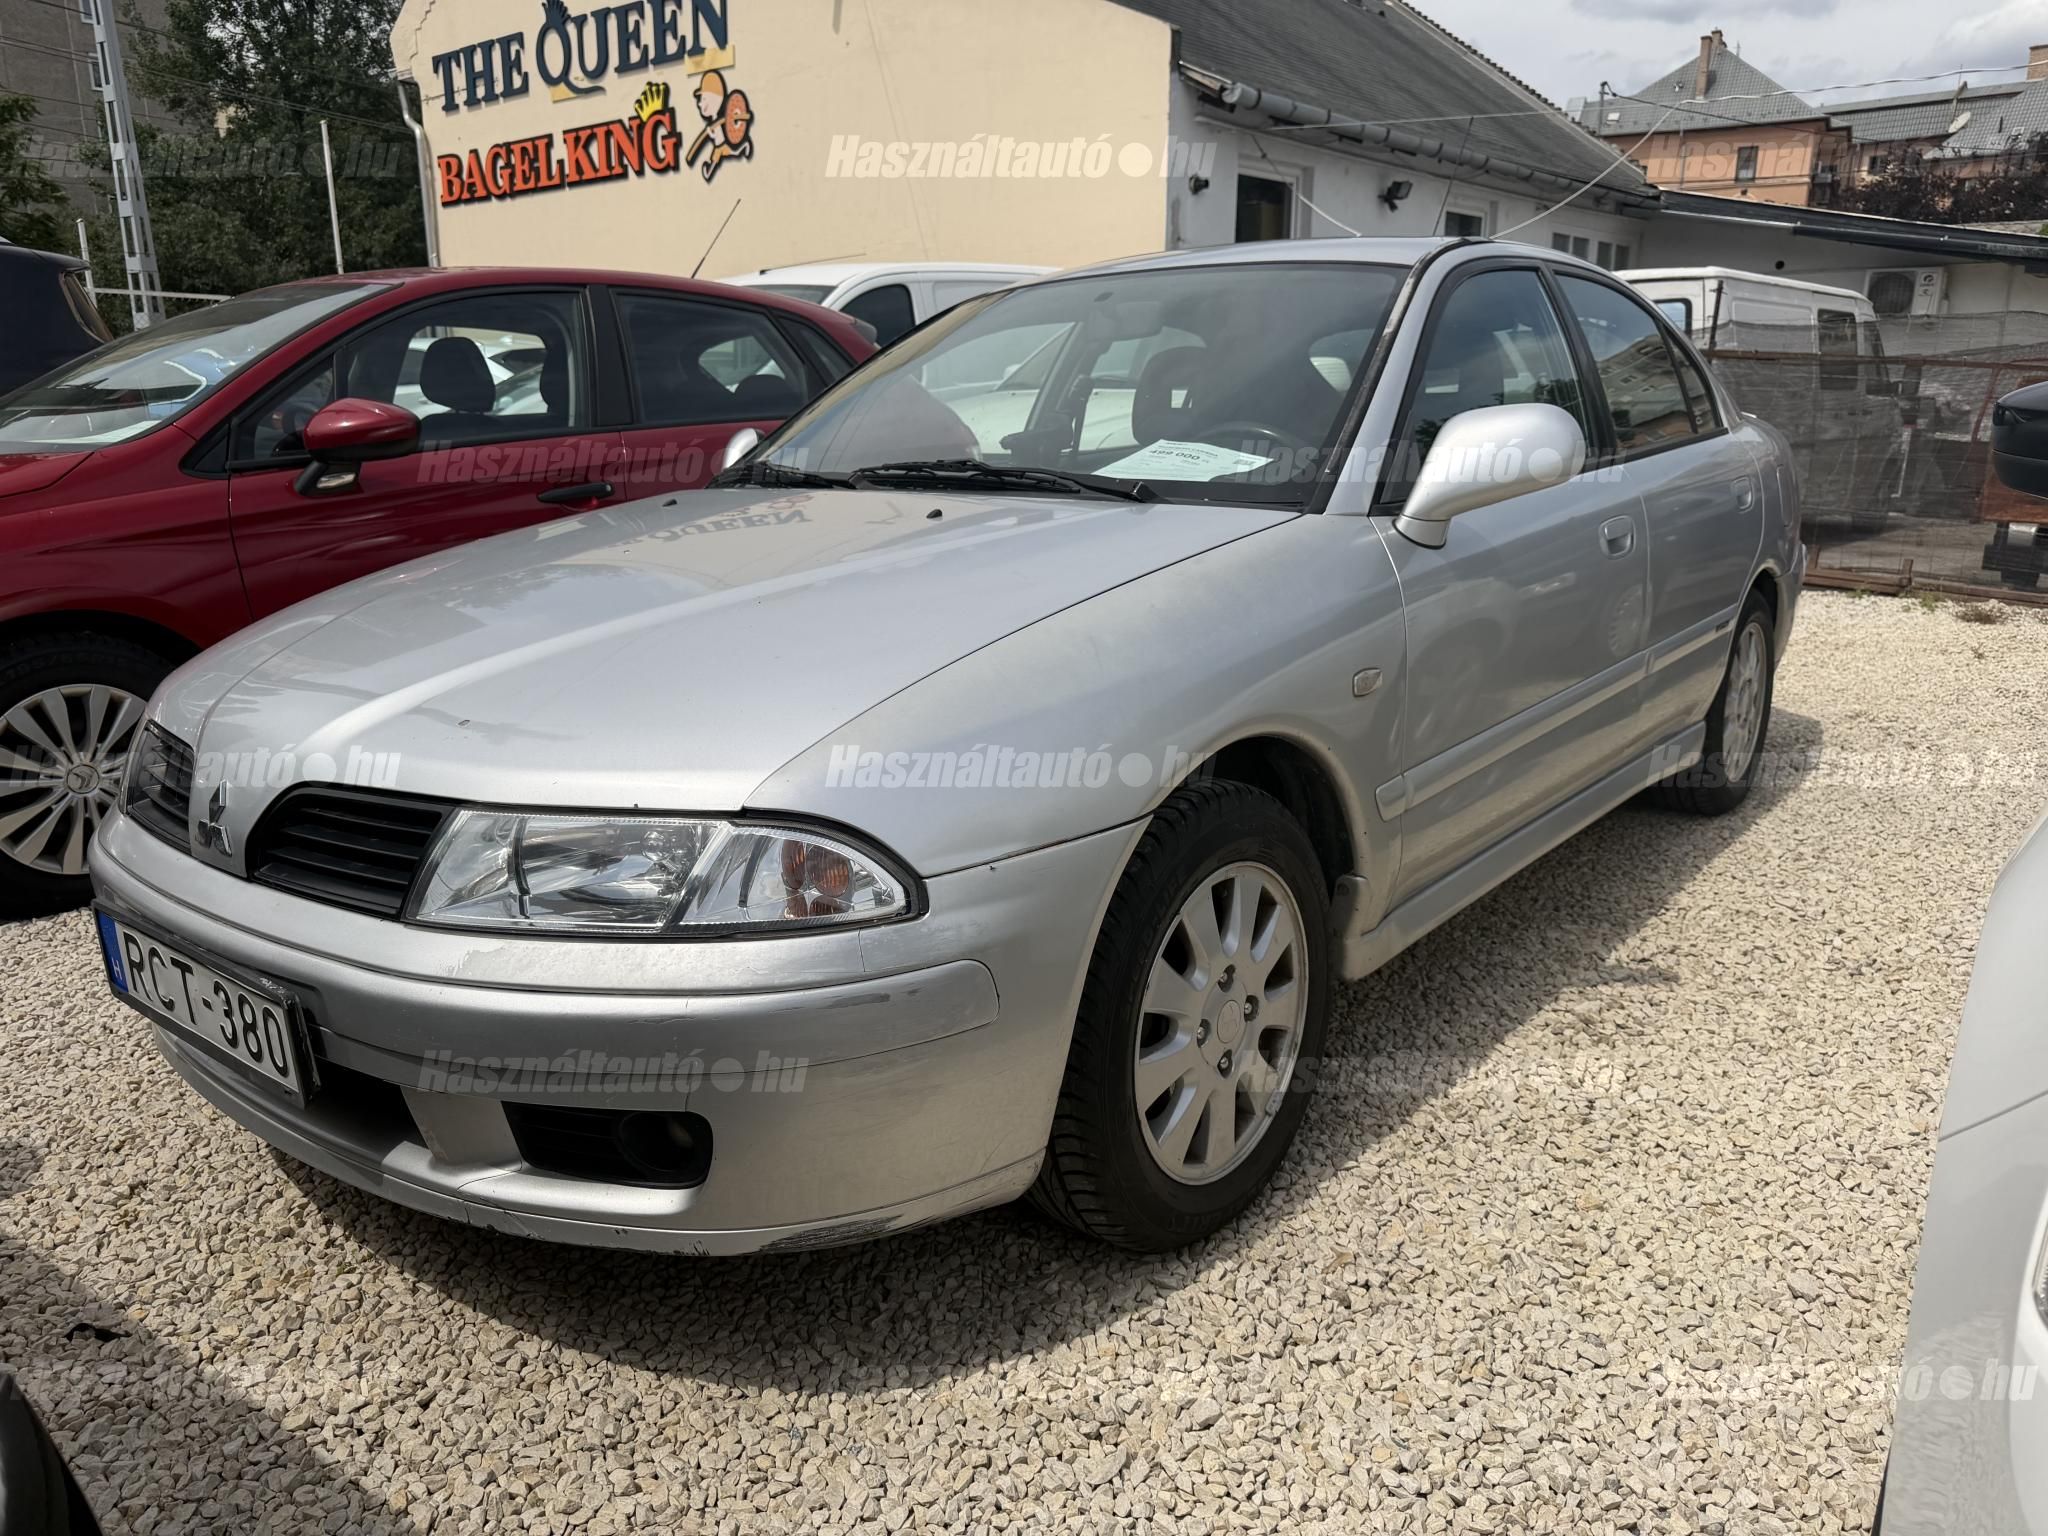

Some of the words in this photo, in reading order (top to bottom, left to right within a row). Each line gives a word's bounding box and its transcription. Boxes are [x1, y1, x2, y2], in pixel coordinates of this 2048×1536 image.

[432, 31, 529, 113] THE
[536, 0, 729, 95] QUEEN
[111, 958, 124, 981] H
[123, 930, 289, 1078] RCT-380
